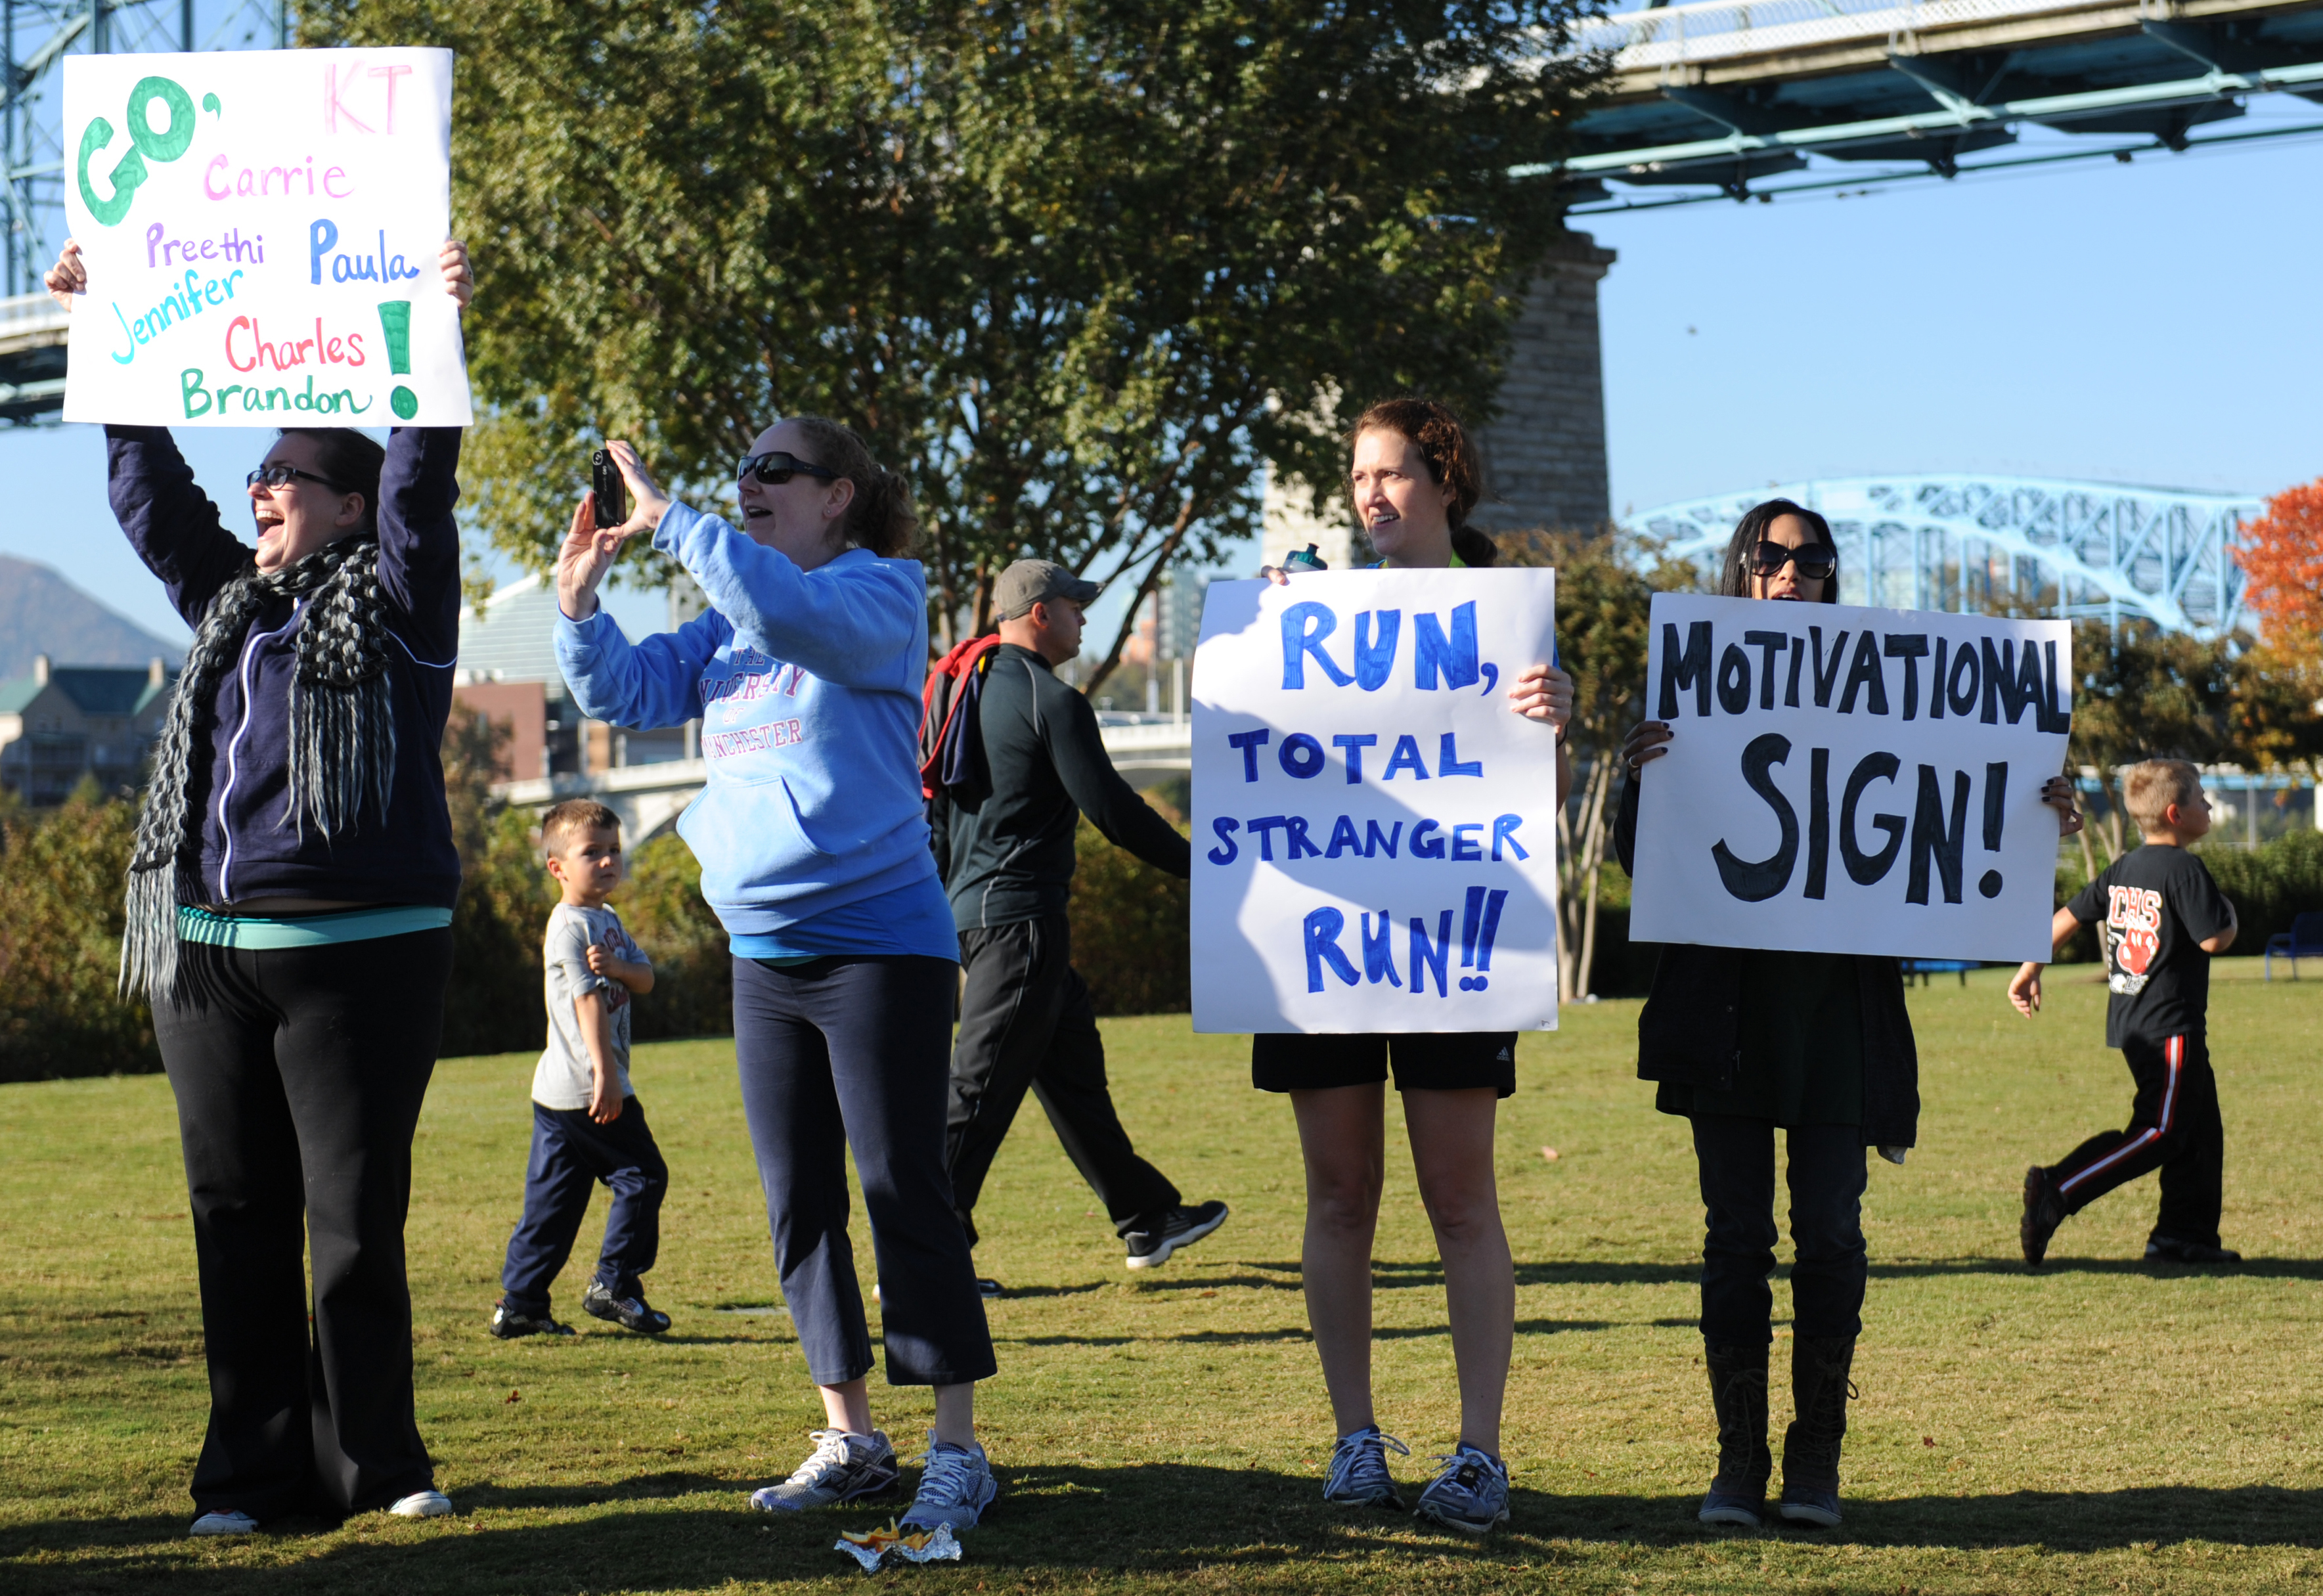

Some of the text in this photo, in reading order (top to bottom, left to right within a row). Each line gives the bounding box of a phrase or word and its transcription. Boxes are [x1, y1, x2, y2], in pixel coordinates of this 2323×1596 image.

[324, 60, 412, 135] KT
[204, 153, 355, 201] Carrie
[146, 218, 420, 285] Preethi Paula
[111, 269, 244, 365] Jennifer
[225, 315, 365, 372] Charles
[181, 368, 373, 420] Brandon
[734, 648, 765, 665] THE
[1281, 600, 1499, 696] RUN,
[1657, 621, 2071, 734] MOTIVATIONAL
[723, 707, 745, 723] OF
[1228, 728, 1484, 785] TOTAL
[1207, 814, 1530, 866] STRANGER
[1710, 732, 2008, 905] SIGN!
[1303, 885, 1509, 998] RUN!!
